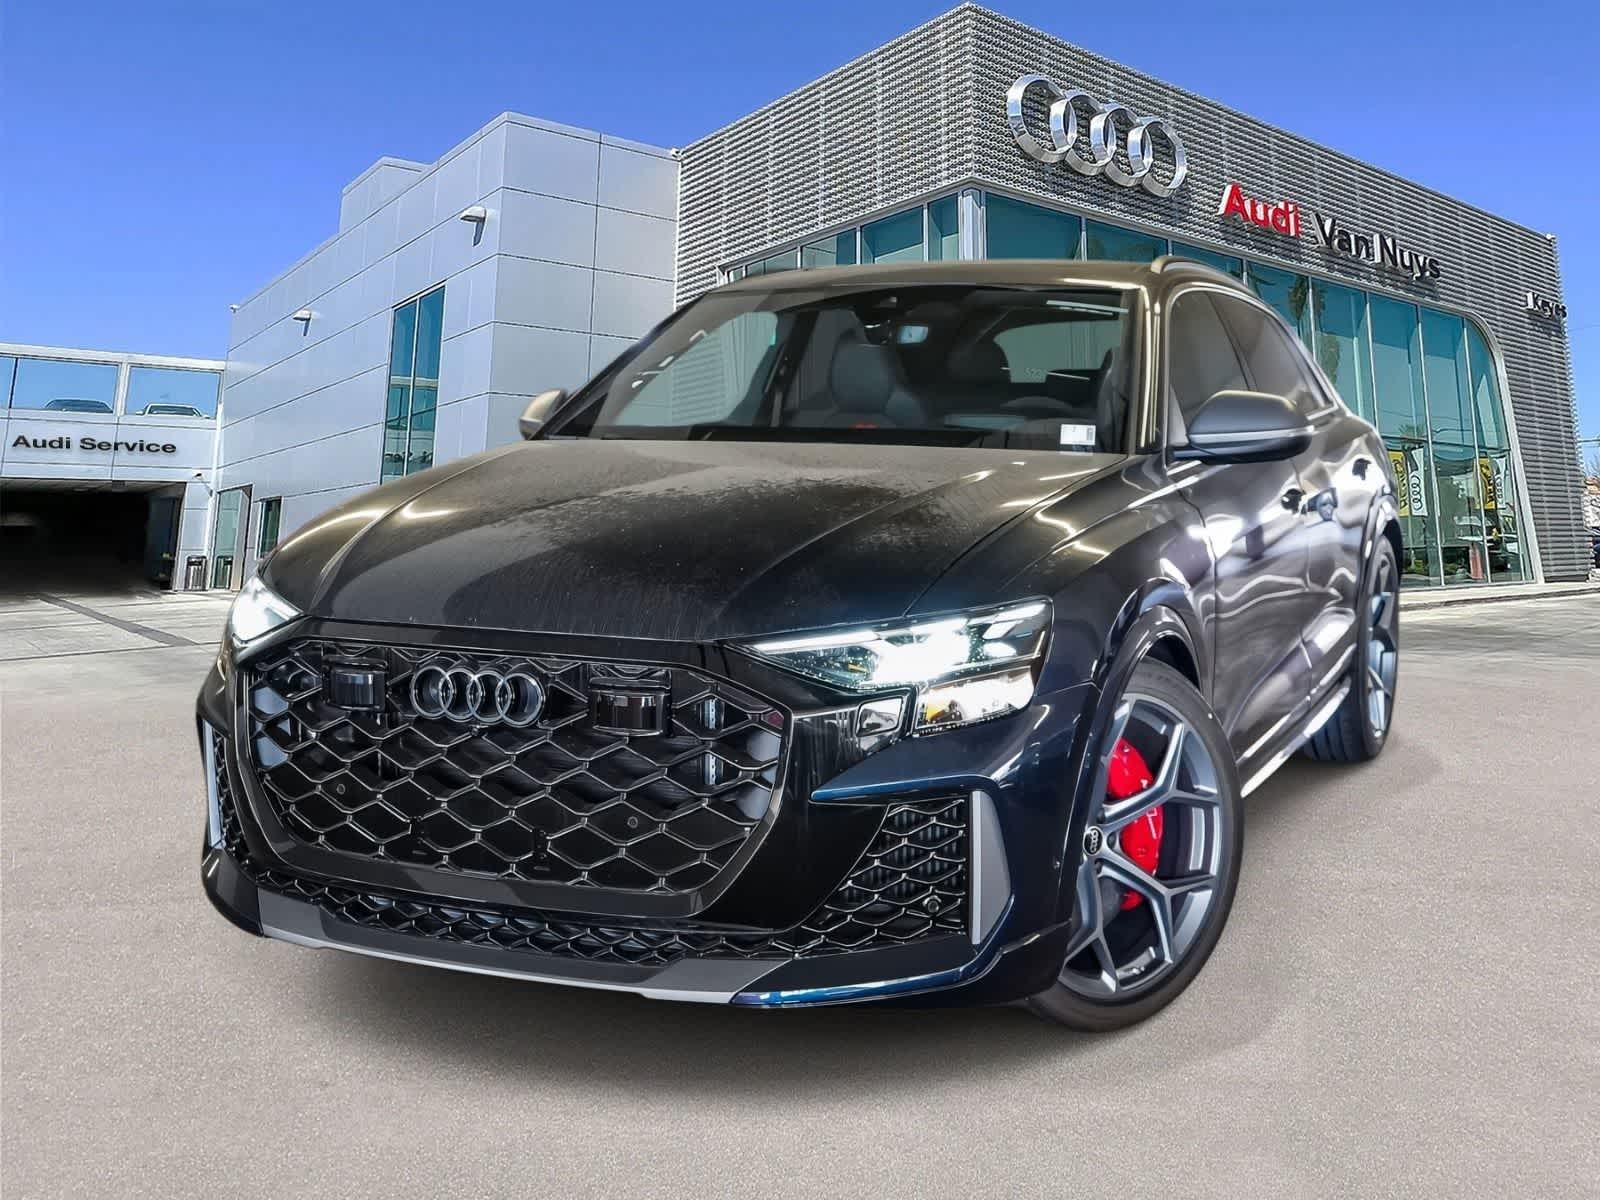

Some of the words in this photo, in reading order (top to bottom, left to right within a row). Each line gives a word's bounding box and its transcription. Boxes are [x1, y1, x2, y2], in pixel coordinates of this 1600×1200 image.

[1218, 182, 1302, 238] Audi
[1311, 212, 1373, 260] Van
[1374, 233, 1440, 280] Nuys
[1527, 291, 1567, 319] Keyes
[12, 435, 71, 449] Audi
[79, 437, 177, 453] Service
